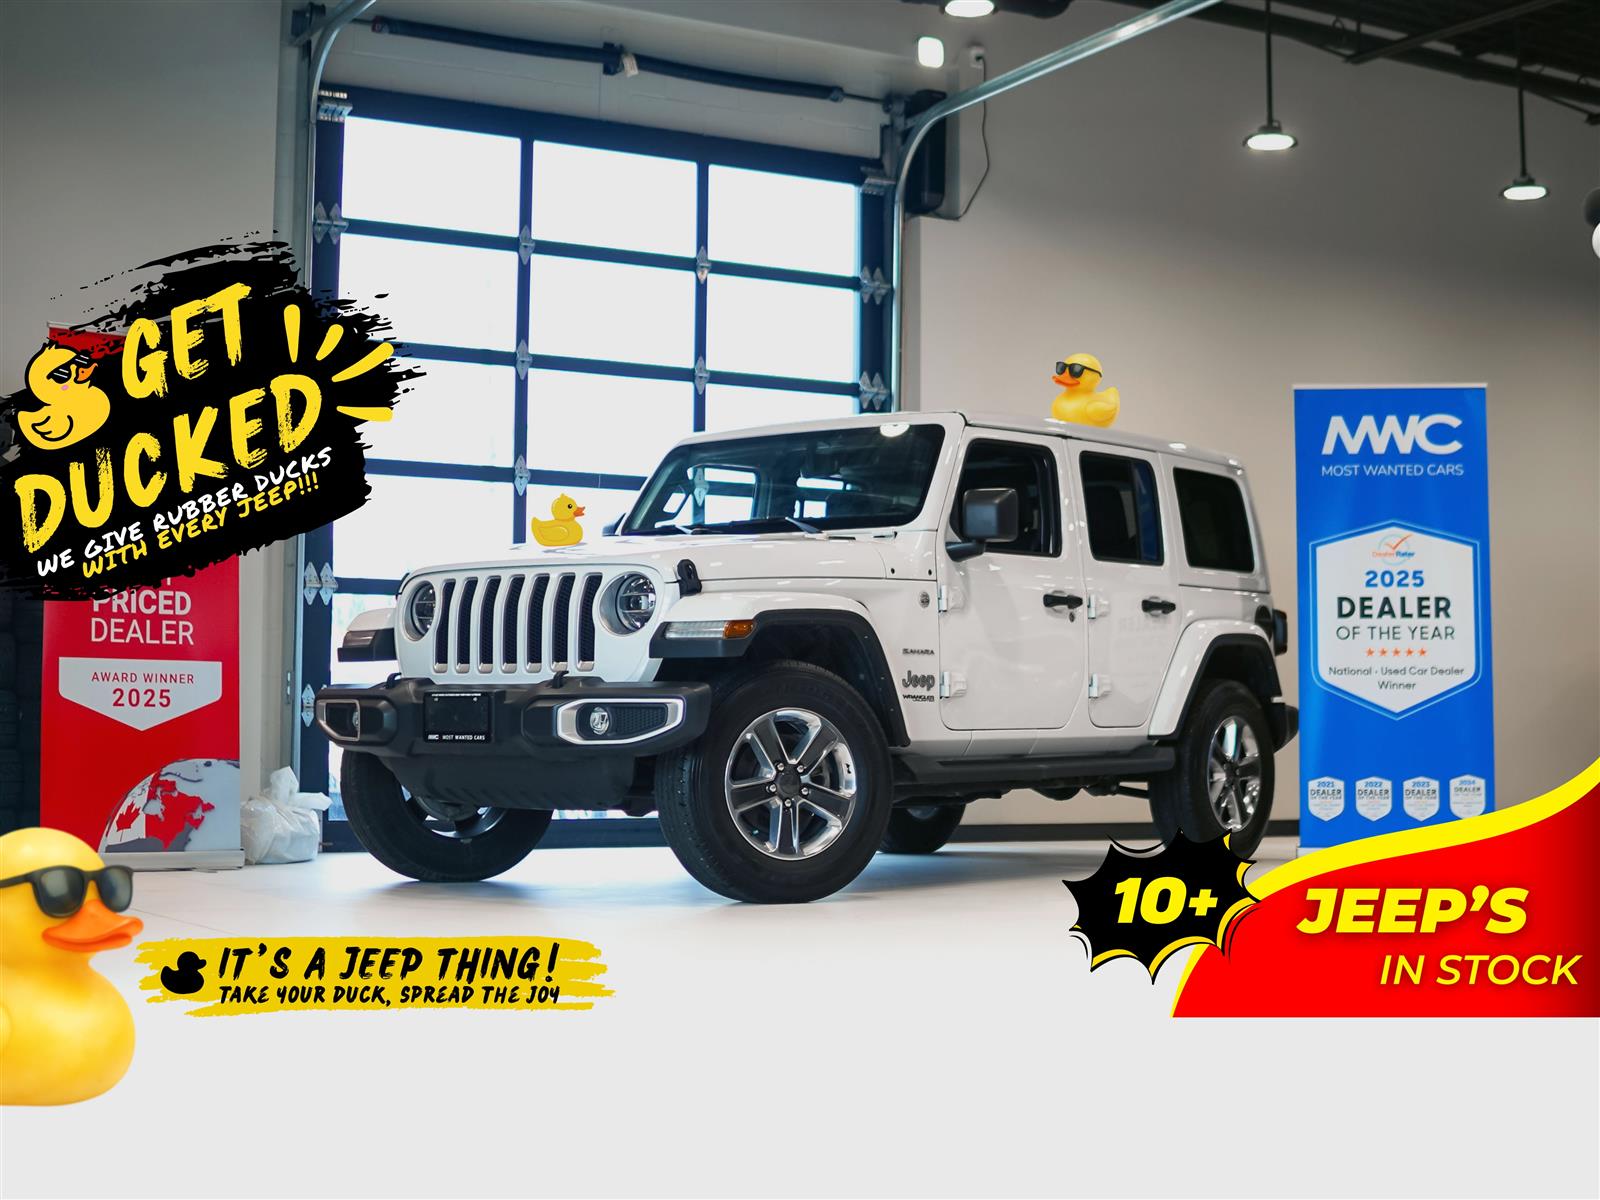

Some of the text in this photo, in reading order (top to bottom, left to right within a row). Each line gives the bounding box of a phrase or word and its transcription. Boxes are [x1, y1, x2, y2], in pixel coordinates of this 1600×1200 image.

[1321, 414, 1463, 455] MWC
[1321, 464, 1464, 477] MOST WANTED CARS
[1365, 570, 1424, 588] 2025
[1337, 596, 1451, 619] DEALER
[90, 617, 194, 645] DEALER
[1336, 626, 1455, 640] OF THE YEAR
[91, 672, 194, 684] AWARD WINNER
[1329, 666, 1372, 676] National
[1381, 666, 1406, 676] Used
[1409, 666, 1428, 676] Car
[1430, 666, 1464, 676] Dealer
[902, 670, 935, 691] Jeep
[1378, 681, 1416, 690] Winner
[112, 688, 171, 707] 2025
